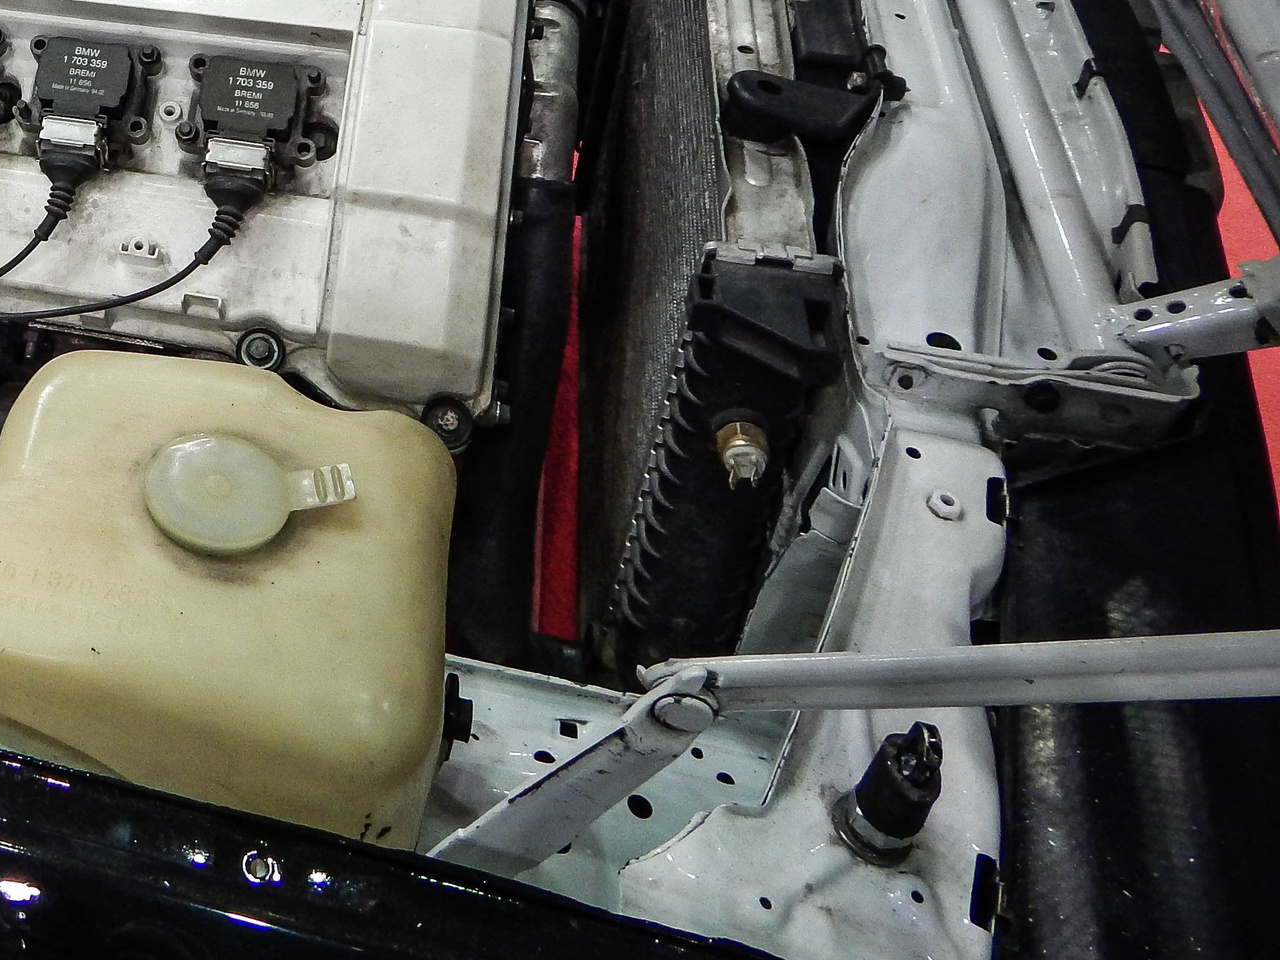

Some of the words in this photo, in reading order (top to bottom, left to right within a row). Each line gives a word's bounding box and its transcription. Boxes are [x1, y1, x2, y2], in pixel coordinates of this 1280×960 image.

[75, 46, 100, 57] BMW
[71, 56, 88, 66] 703
[89, 58, 108, 69] 359
[69, 67, 96, 77] BREMI
[239, 67, 266, 78] BMW
[79, 79, 92, 87] 856
[236, 77, 253, 87] 703
[255, 80, 274, 90] 359
[234, 89, 263, 100] BREMI
[244, 101, 260, 109] 856
